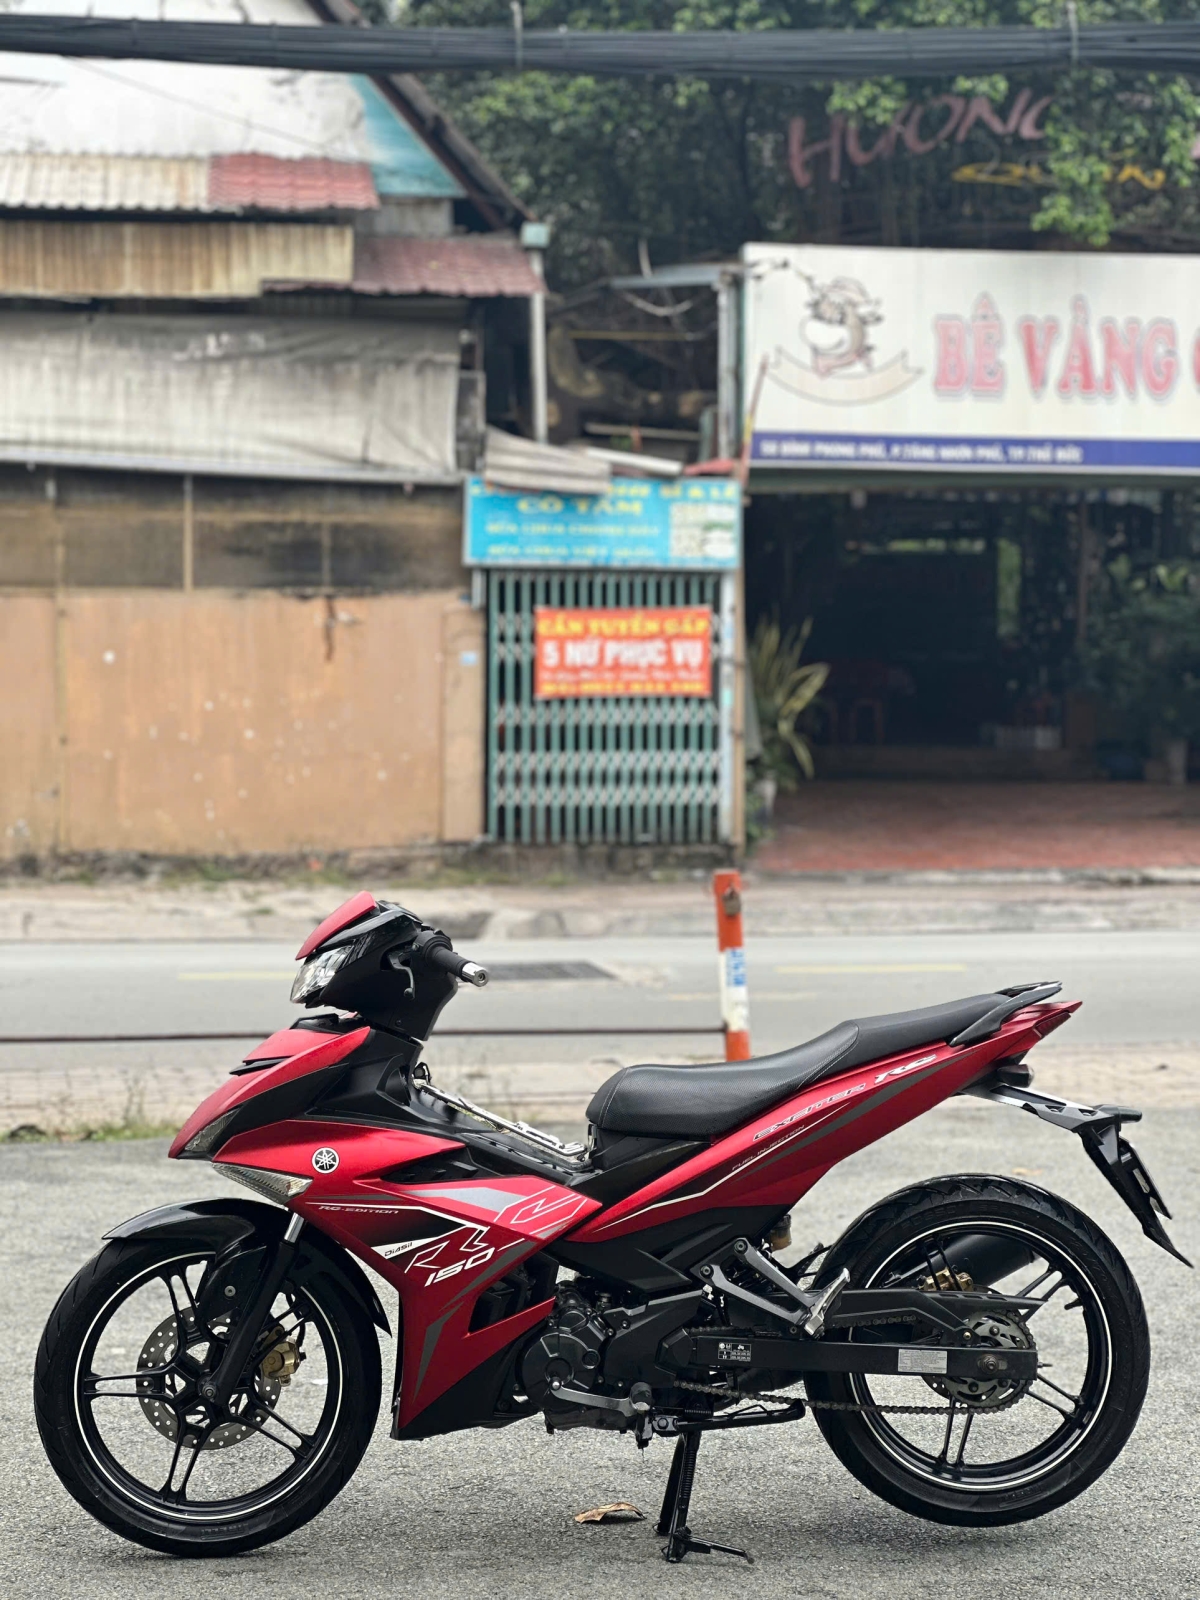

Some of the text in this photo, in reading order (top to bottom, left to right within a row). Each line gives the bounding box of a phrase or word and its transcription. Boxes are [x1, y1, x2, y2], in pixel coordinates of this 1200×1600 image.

[934, 292, 1006, 395] BÊ
[543, 634, 703, 672] 5 NỮ PHỤC VỤ
[424, 1247, 496, 1288] 150
